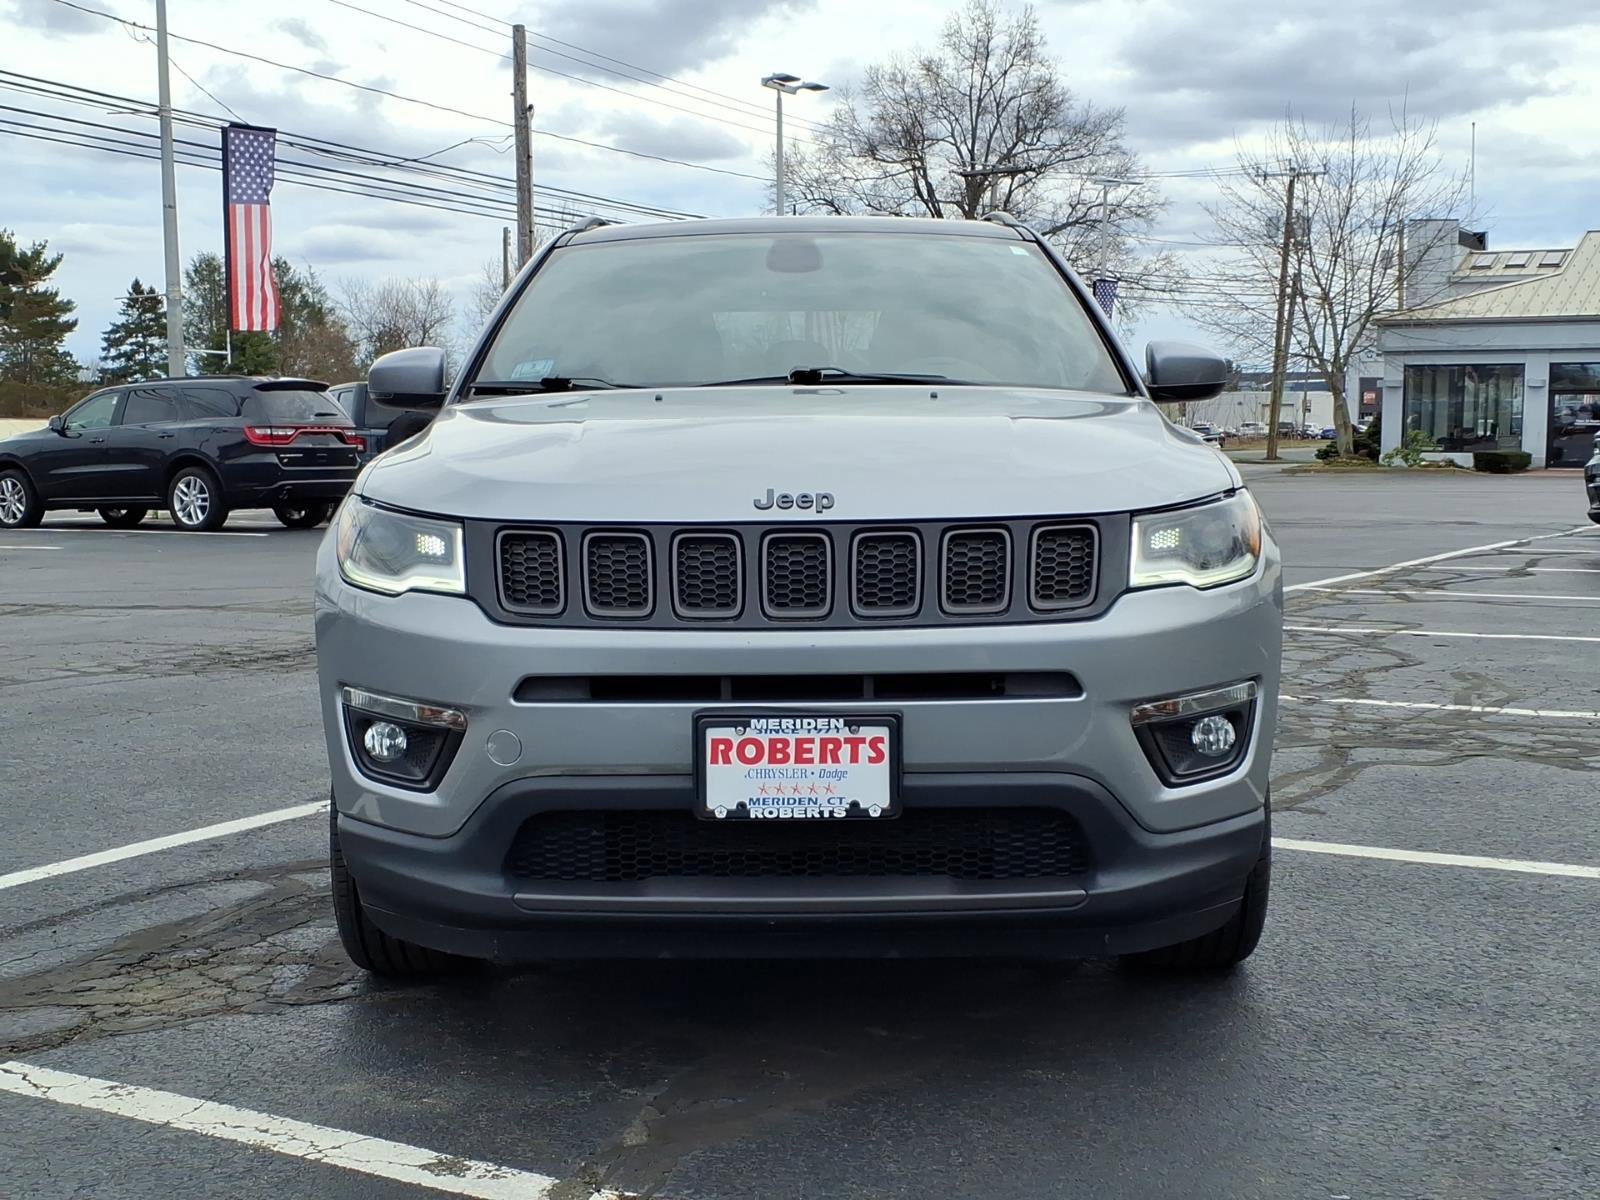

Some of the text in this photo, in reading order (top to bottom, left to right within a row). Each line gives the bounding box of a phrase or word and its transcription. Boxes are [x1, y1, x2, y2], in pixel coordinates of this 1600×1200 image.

[753, 488, 835, 513] Jeep
[750, 718, 844, 730] MERIDEN
[709, 736, 886, 765] ROBERTS
[818, 768, 848, 781] Dodge
[749, 806, 848, 819] ROBERTS
